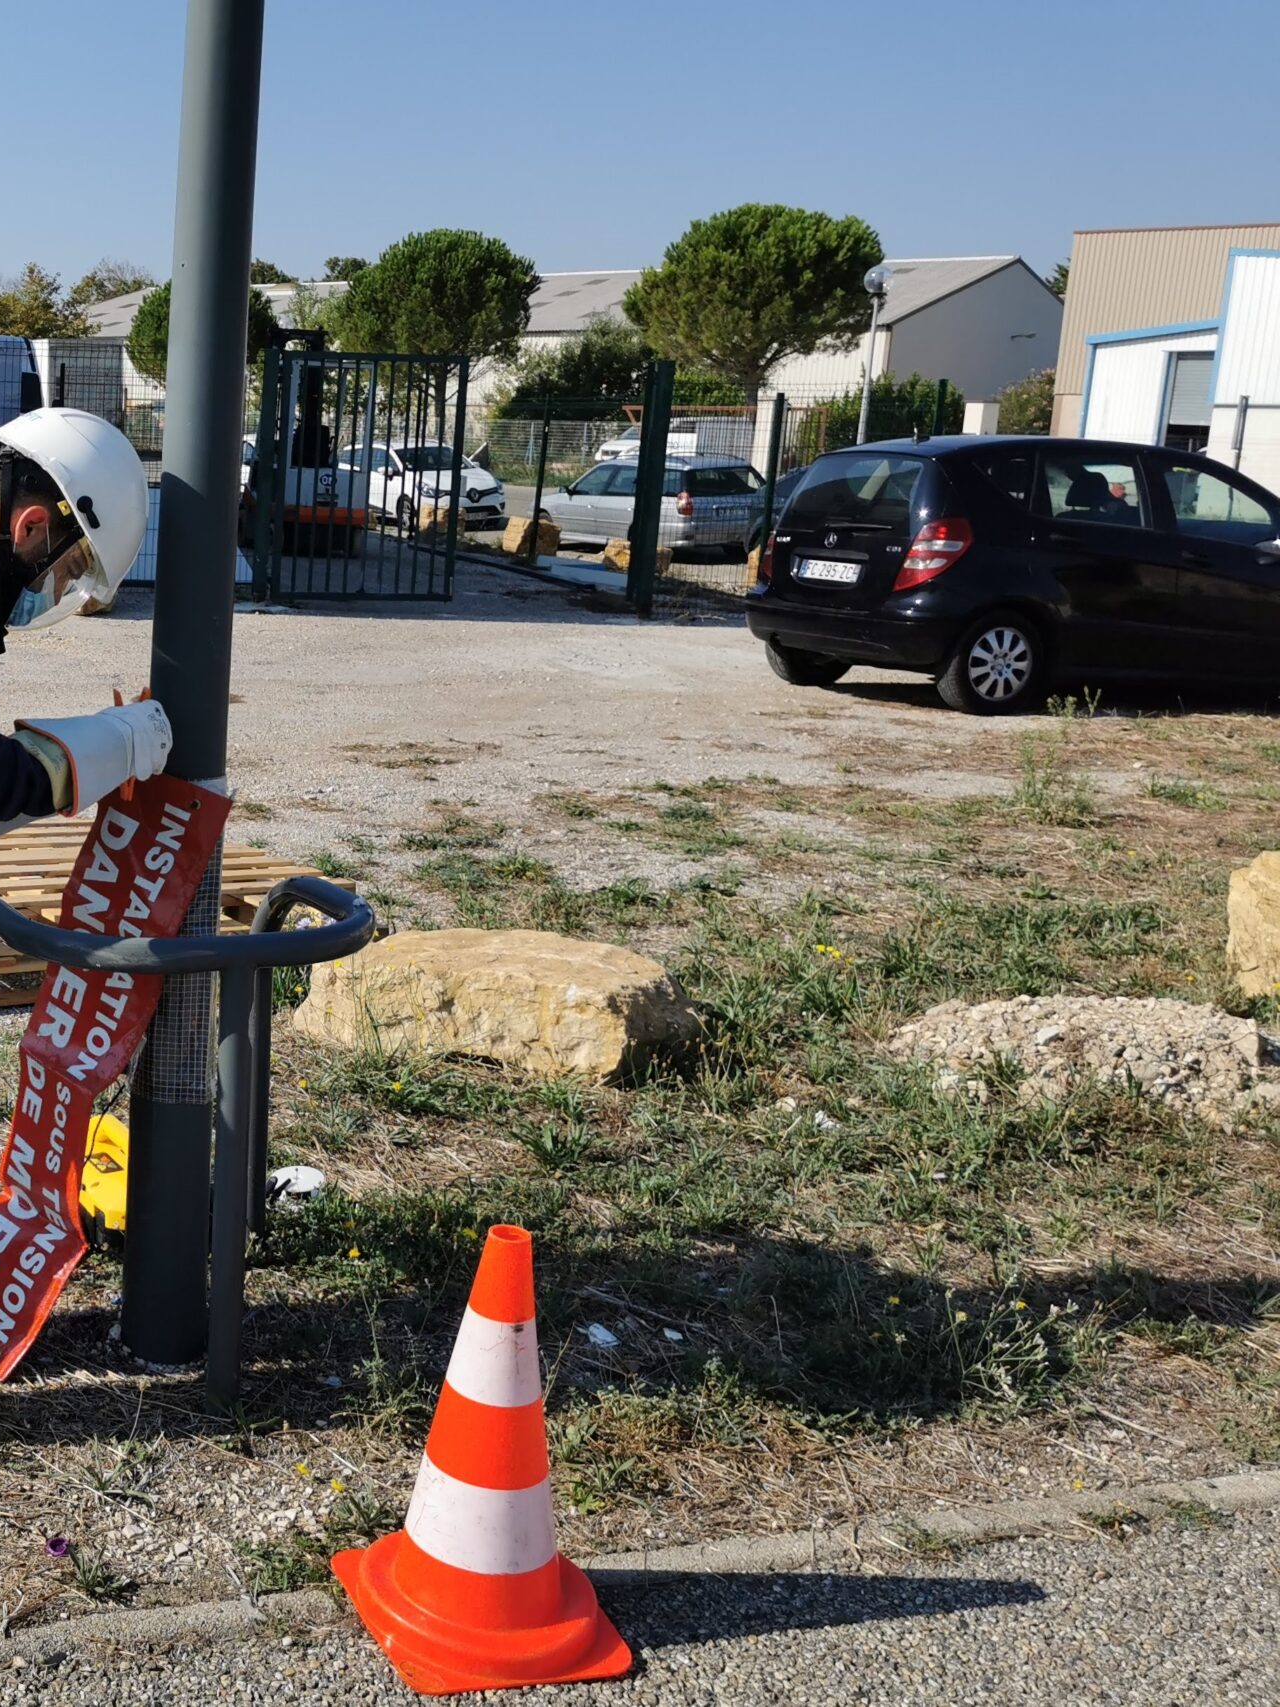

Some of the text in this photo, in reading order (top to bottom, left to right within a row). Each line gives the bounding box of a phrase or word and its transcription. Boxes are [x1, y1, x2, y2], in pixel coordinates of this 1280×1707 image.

[37, 806, 140, 1048] DANER
[66, 803, 192, 1081] INSTALATION
[21, 1054, 46, 1125] DE
[45, 1081, 71, 1174] SOUS
